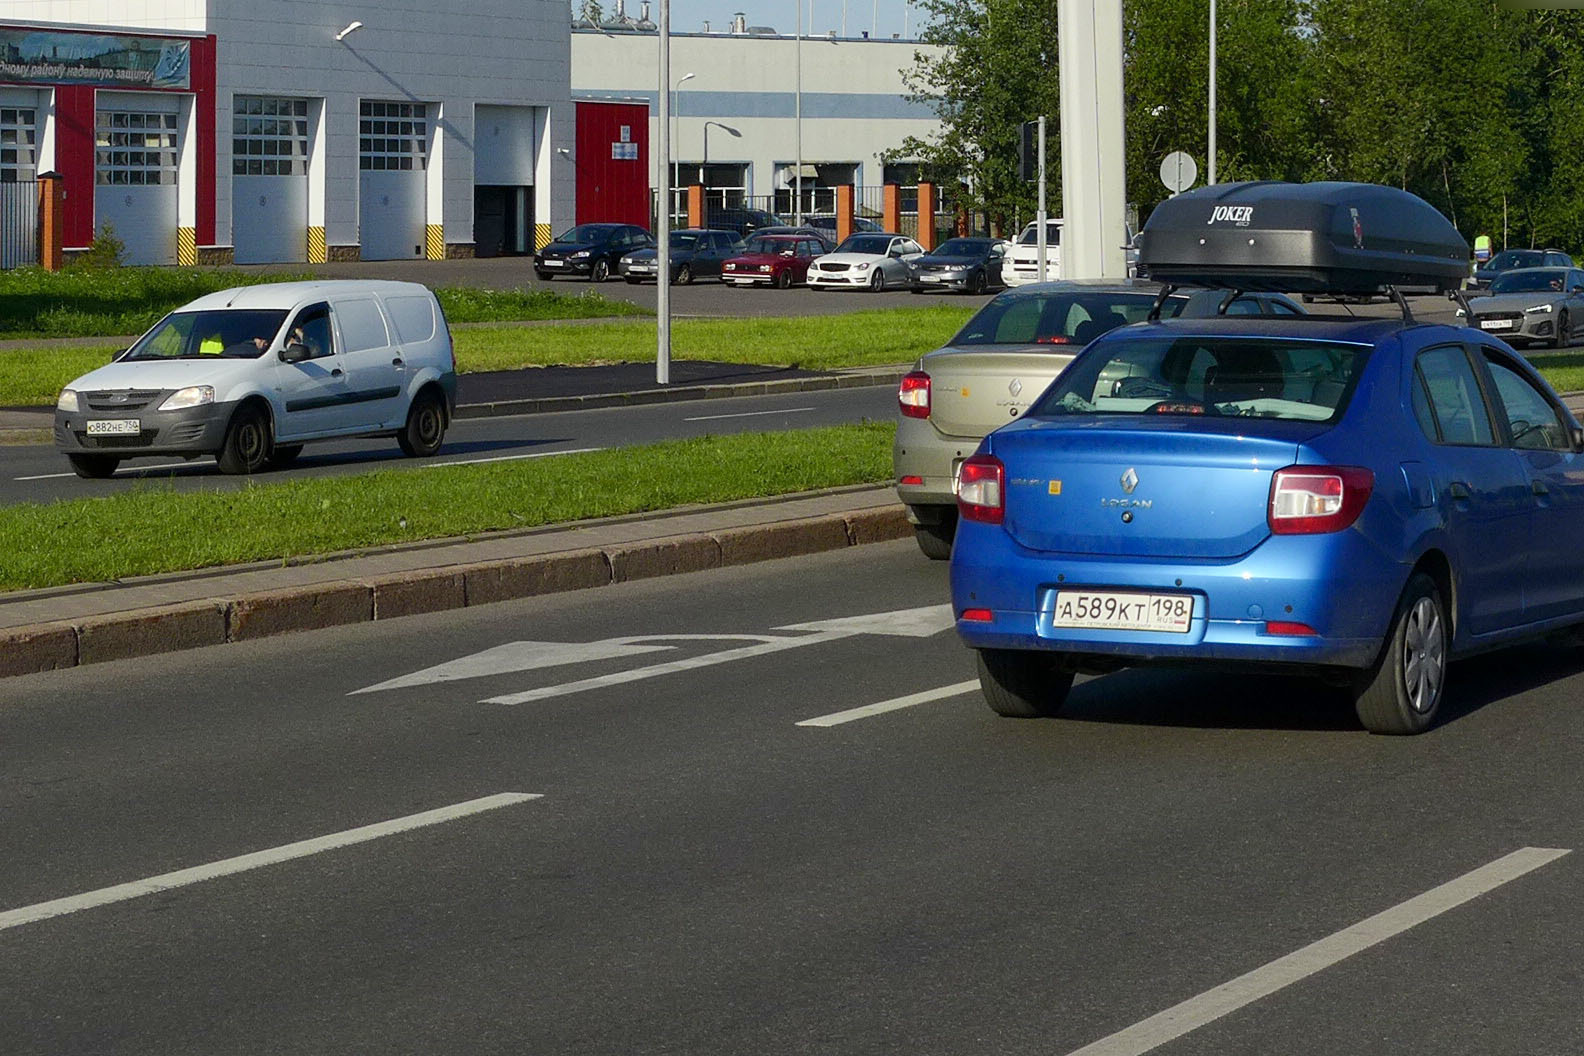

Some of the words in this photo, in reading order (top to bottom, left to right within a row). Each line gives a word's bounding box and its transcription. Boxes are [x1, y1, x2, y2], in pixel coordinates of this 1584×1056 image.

[1207, 206, 1253, 225] JOKER
[1061, 596, 1146, 621] А589КТ
[1152, 598, 1185, 617] 198
